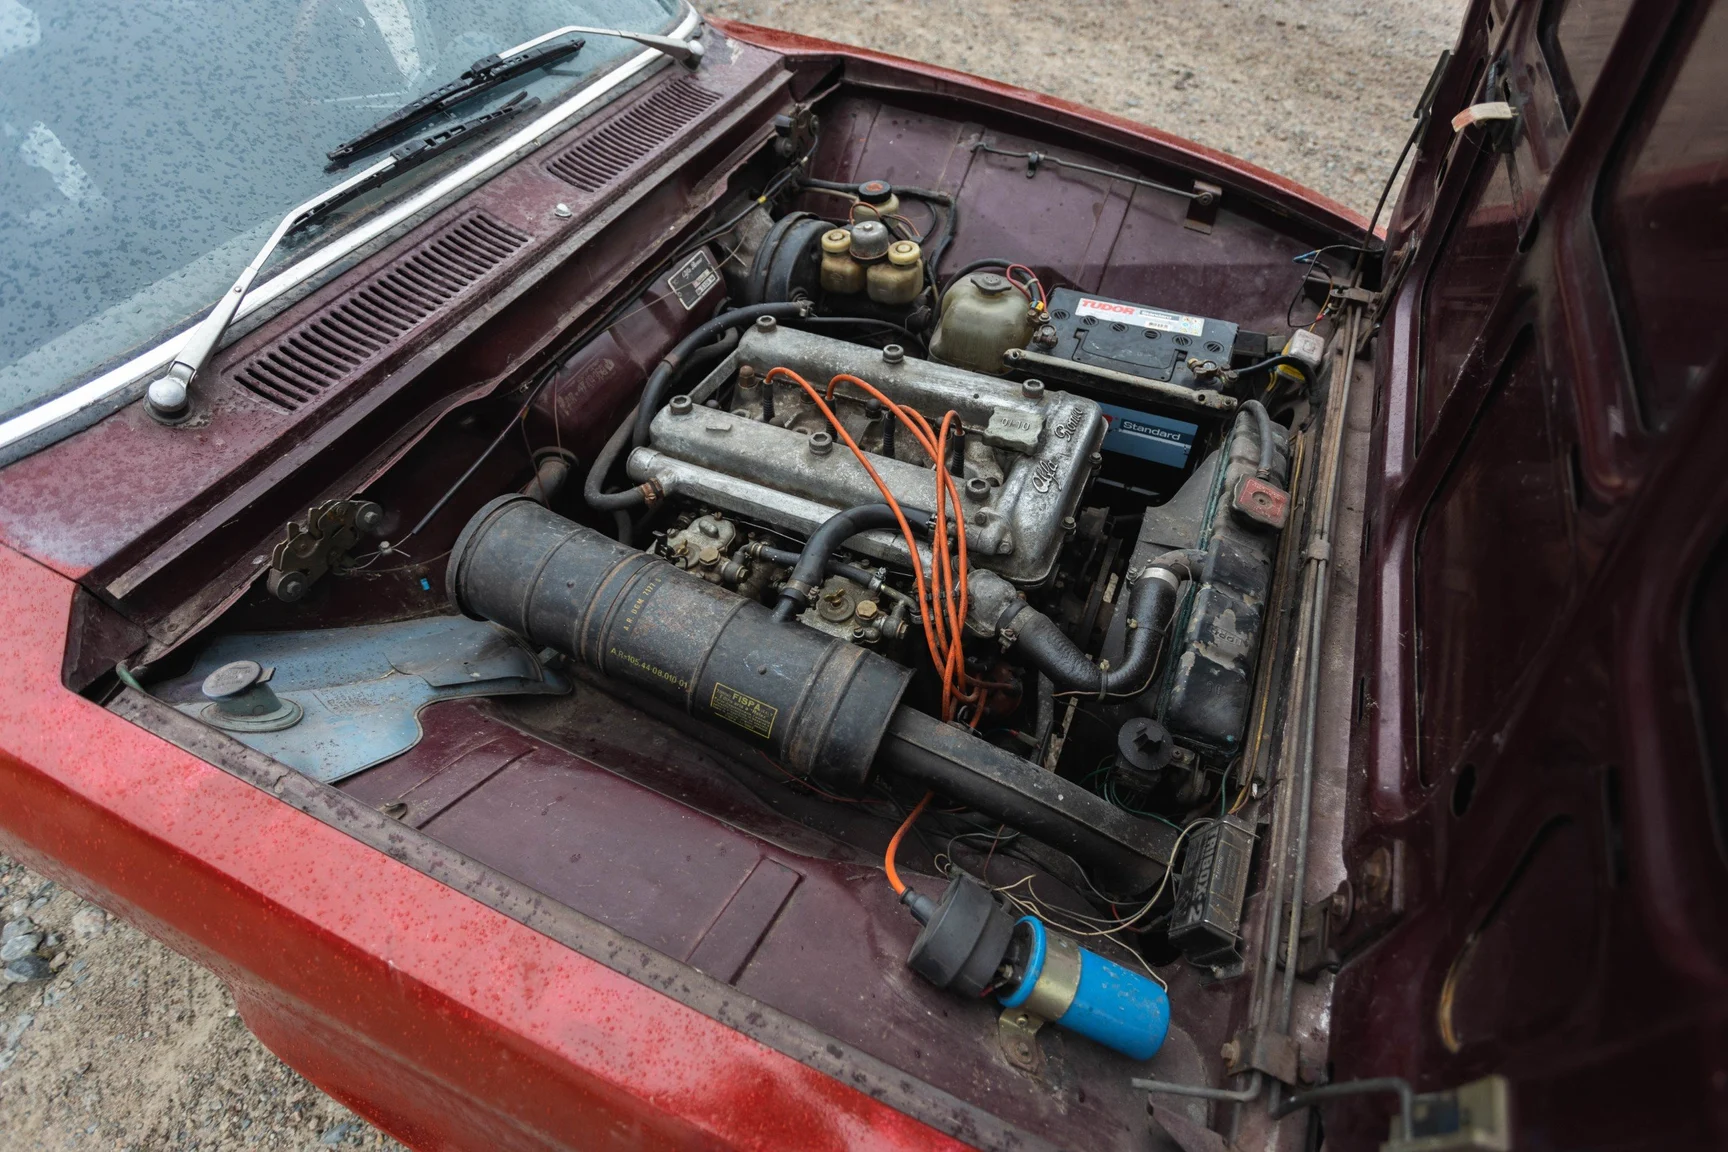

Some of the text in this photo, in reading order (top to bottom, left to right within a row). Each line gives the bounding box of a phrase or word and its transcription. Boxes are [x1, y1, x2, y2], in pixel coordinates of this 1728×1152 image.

[1082, 299, 1136, 316] TUDOR
[1123, 420, 1181, 441] Standard
[1032, 460, 1062, 494] Alfa
[732, 692, 761, 711] FISPA
